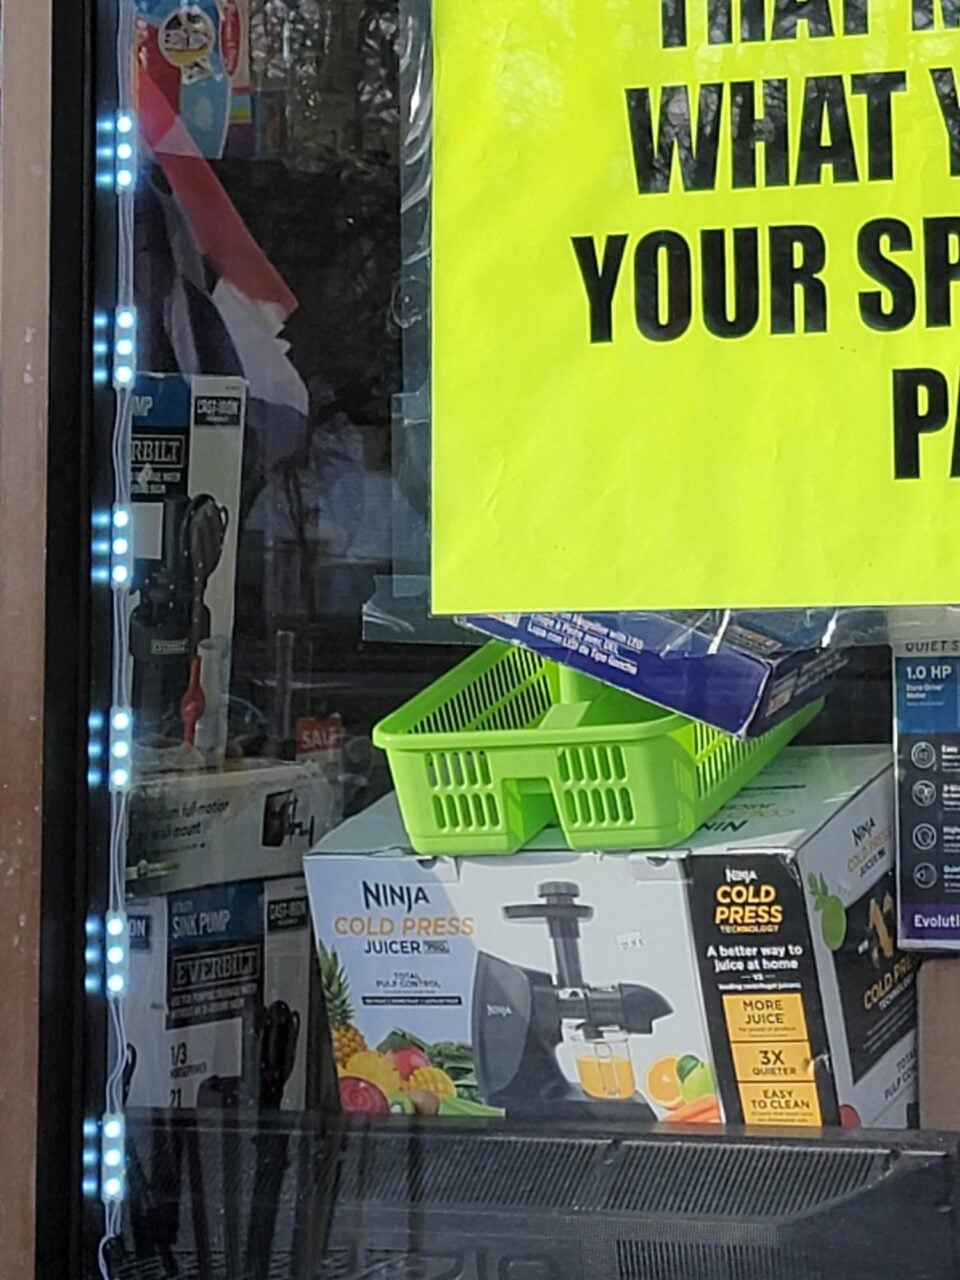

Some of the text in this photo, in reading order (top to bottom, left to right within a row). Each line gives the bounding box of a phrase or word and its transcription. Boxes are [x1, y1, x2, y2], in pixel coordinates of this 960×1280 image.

[628, 72, 906, 193] WHAT
[573, 226, 828, 342] YOUR
[132, 440, 180, 461] RBILT
[905, 640, 948, 652] QUIET
[906, 665, 952, 680] 1.0 HP
[302, 727, 340, 749] SALE
[362, 880, 430, 913] NINJA
[716, 885, 776, 904] COLD
[172, 910, 231, 939] SINK PUMP
[715, 905, 783, 925] PRESS
[334, 916, 475, 936] COLD PRESS
[364, 940, 421, 955] JUICER
[706, 944, 803, 958] A better way to
[176, 951, 257, 986] EVERBILT
[747, 960, 760, 971] at
[762, 958, 799, 970] home
[864, 973, 893, 1010] COLD
[743, 1000, 784, 1011] MORE
[745, 1013, 785, 1024] JUICE
[171, 1042, 188, 1067] 1/3
[758, 1050, 785, 1066] 3X
[753, 1067, 797, 1076] QUIETER
[762, 1089, 793, 1099] EASY
[751, 1099, 810, 1109] TO CLEAN
